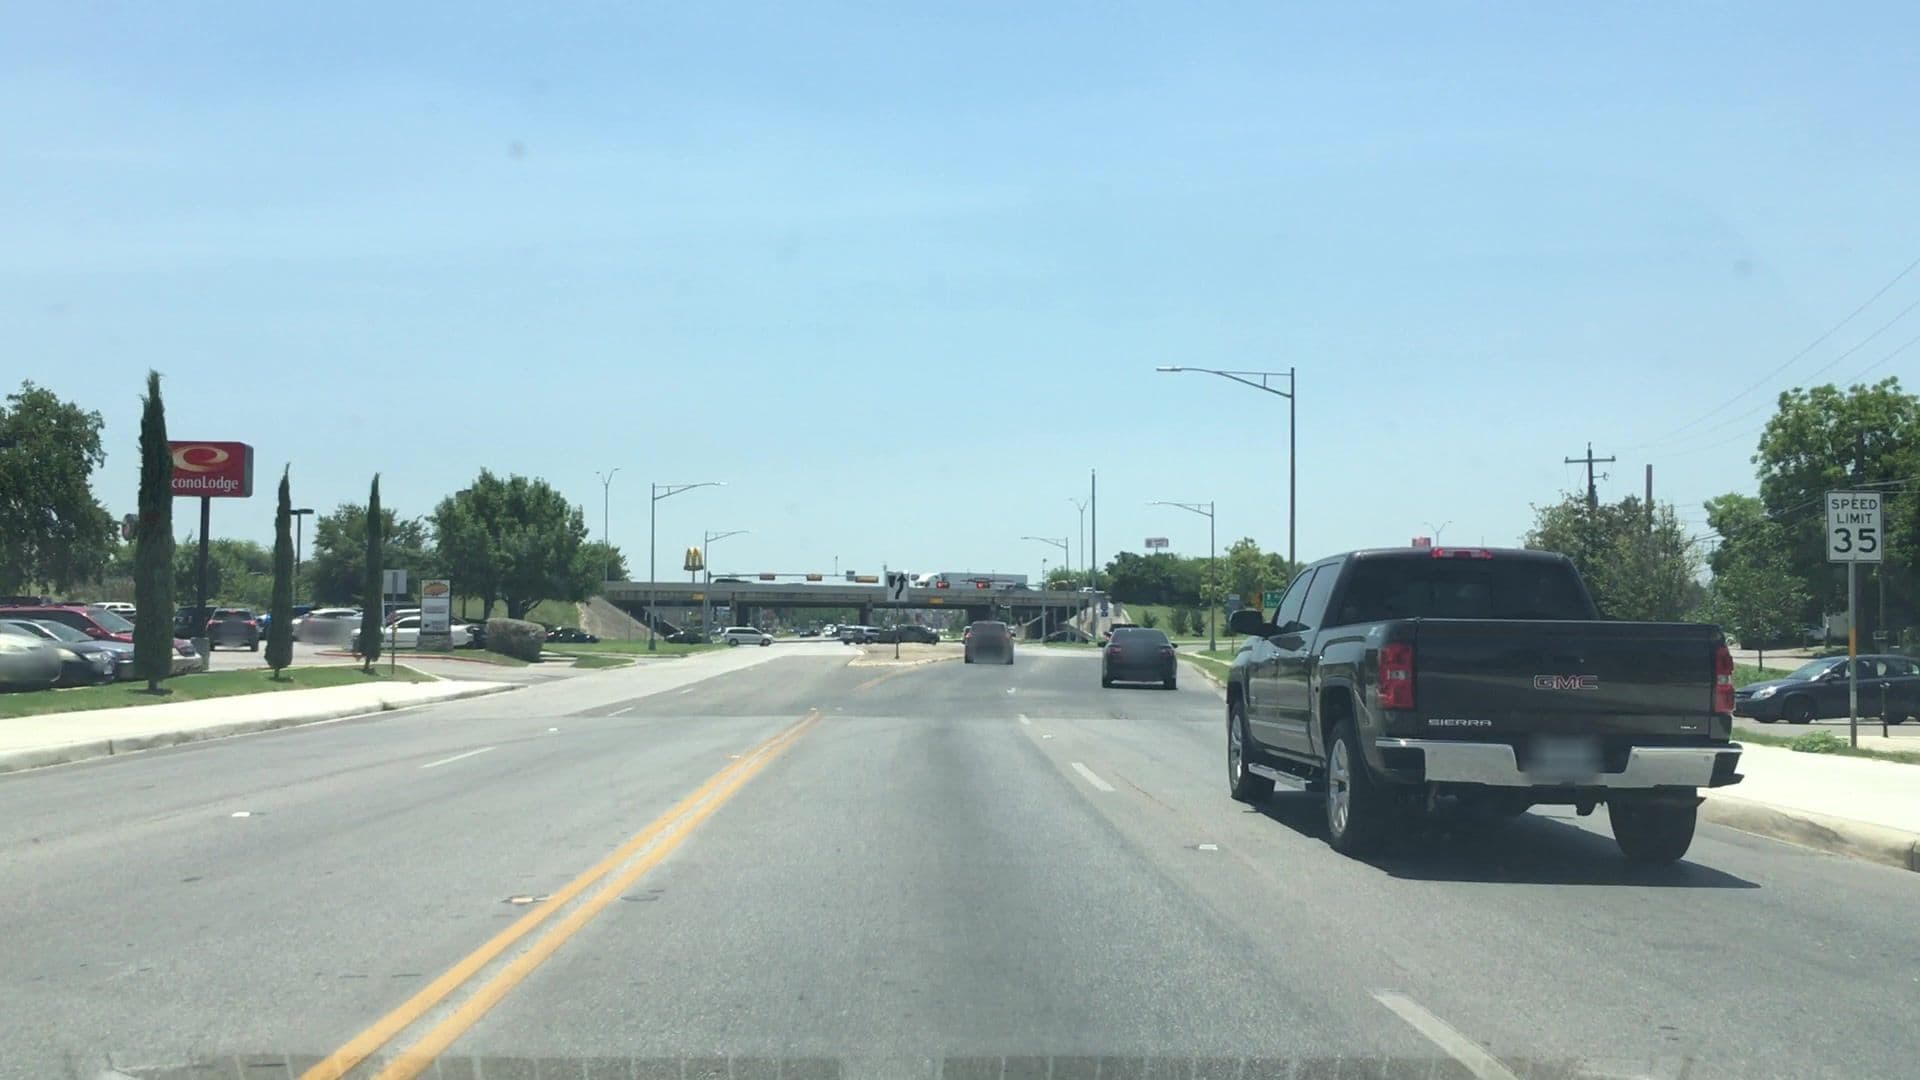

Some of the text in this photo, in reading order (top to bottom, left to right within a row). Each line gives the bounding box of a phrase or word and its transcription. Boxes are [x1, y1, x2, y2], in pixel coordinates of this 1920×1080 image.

[171, 475, 239, 492] conoLodge
[1831, 498, 1878, 510] SPEED
[1836, 513, 1872, 524] LIMIT
[1833, 528, 1877, 553] 35
[1533, 674, 1599, 690] GMC
[1428, 718, 1492, 727] SIERRA
